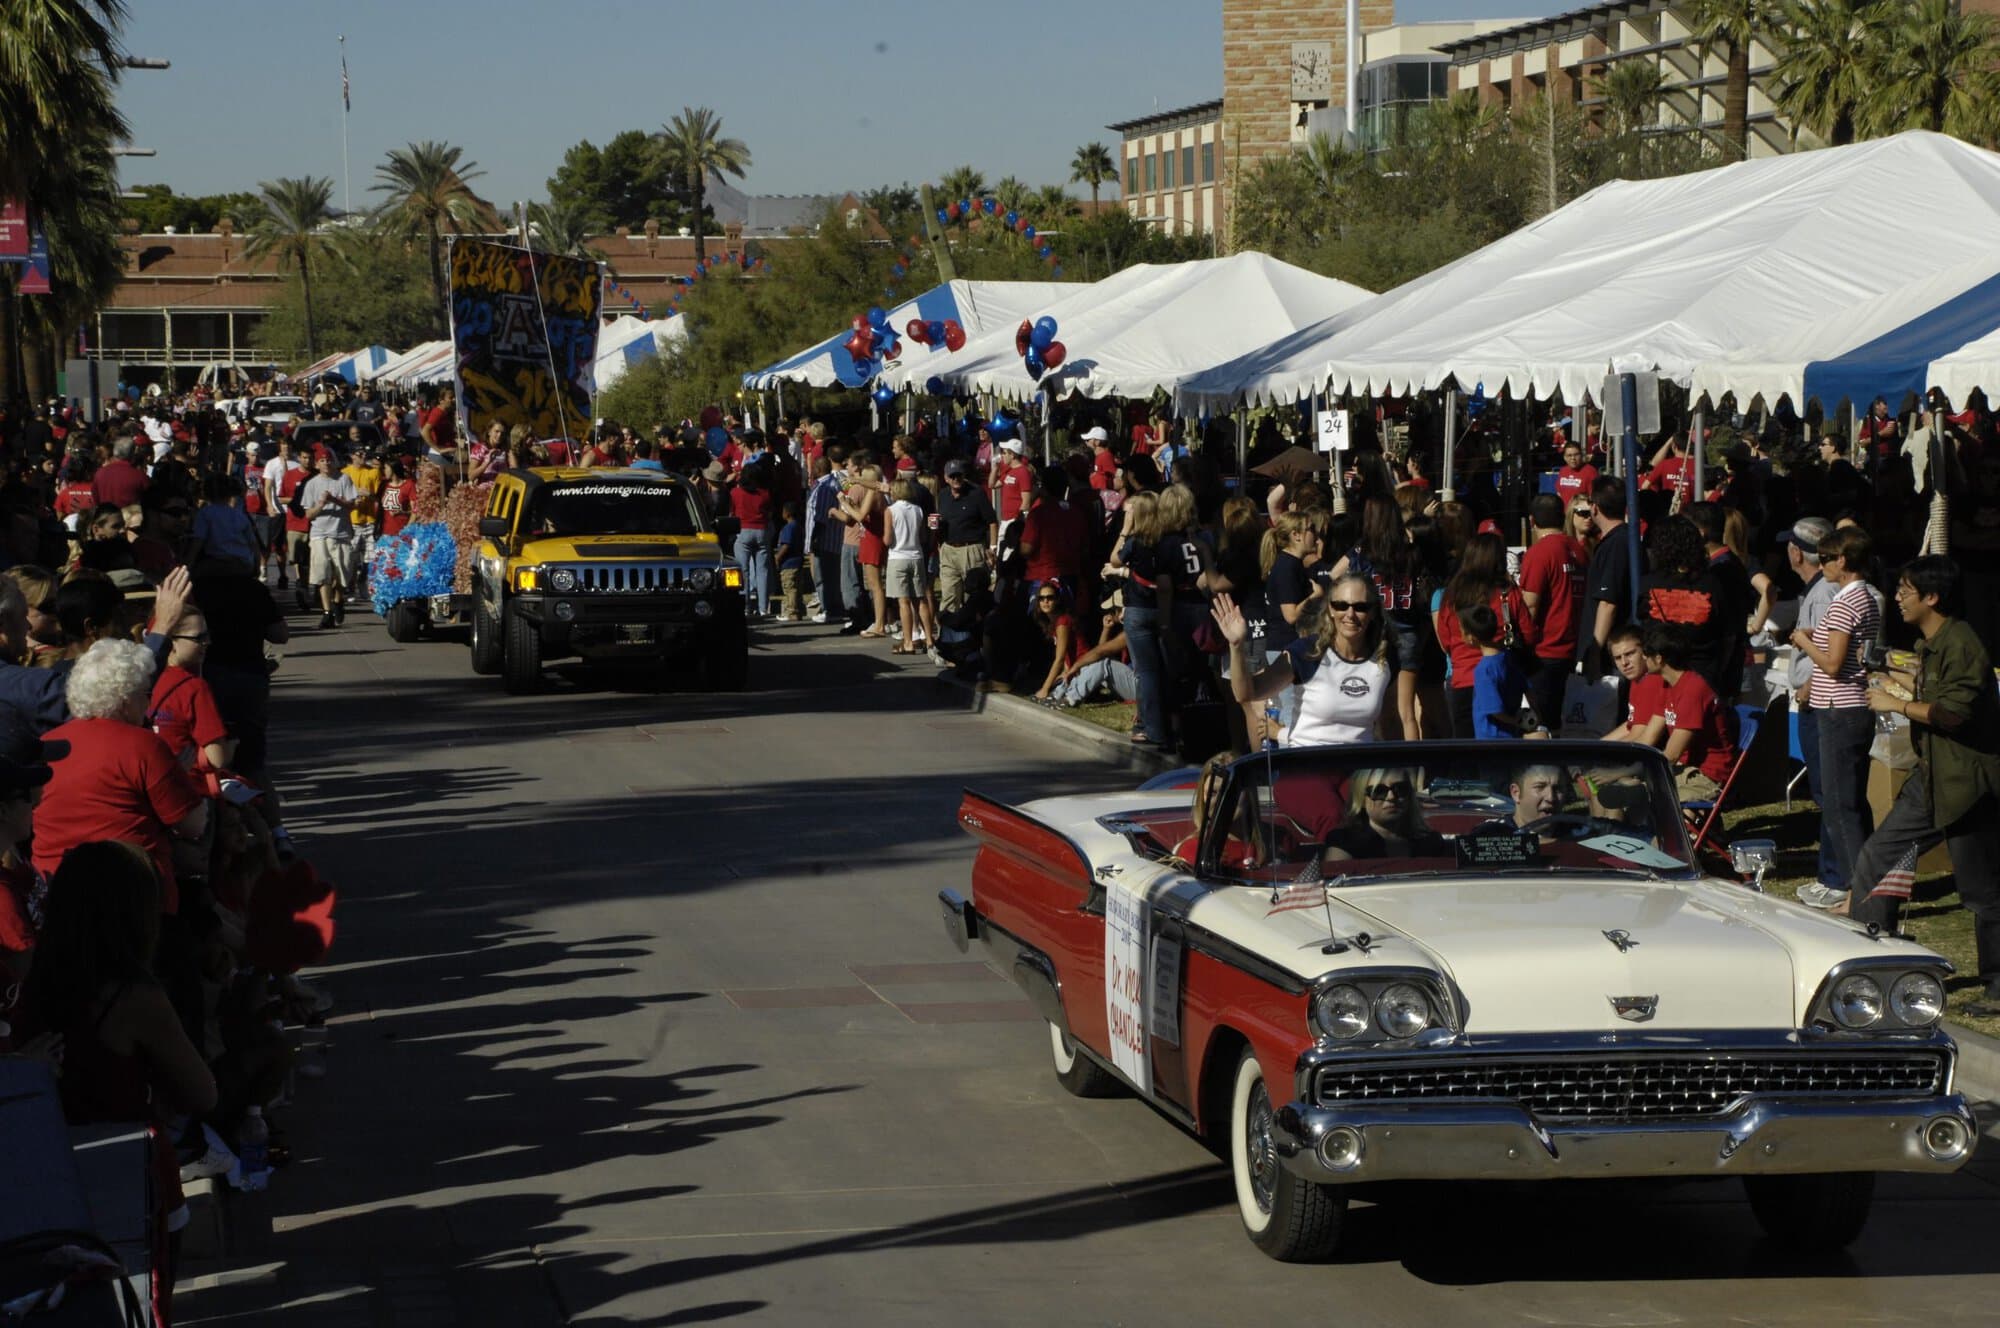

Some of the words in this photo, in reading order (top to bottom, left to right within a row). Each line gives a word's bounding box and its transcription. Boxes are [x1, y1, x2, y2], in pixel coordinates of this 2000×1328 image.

[490, 293, 551, 361] A
[1323, 418, 1343, 434] 24
[382, 488, 402, 511] A
[552, 485, 672, 498] www.tridentgrill.com
